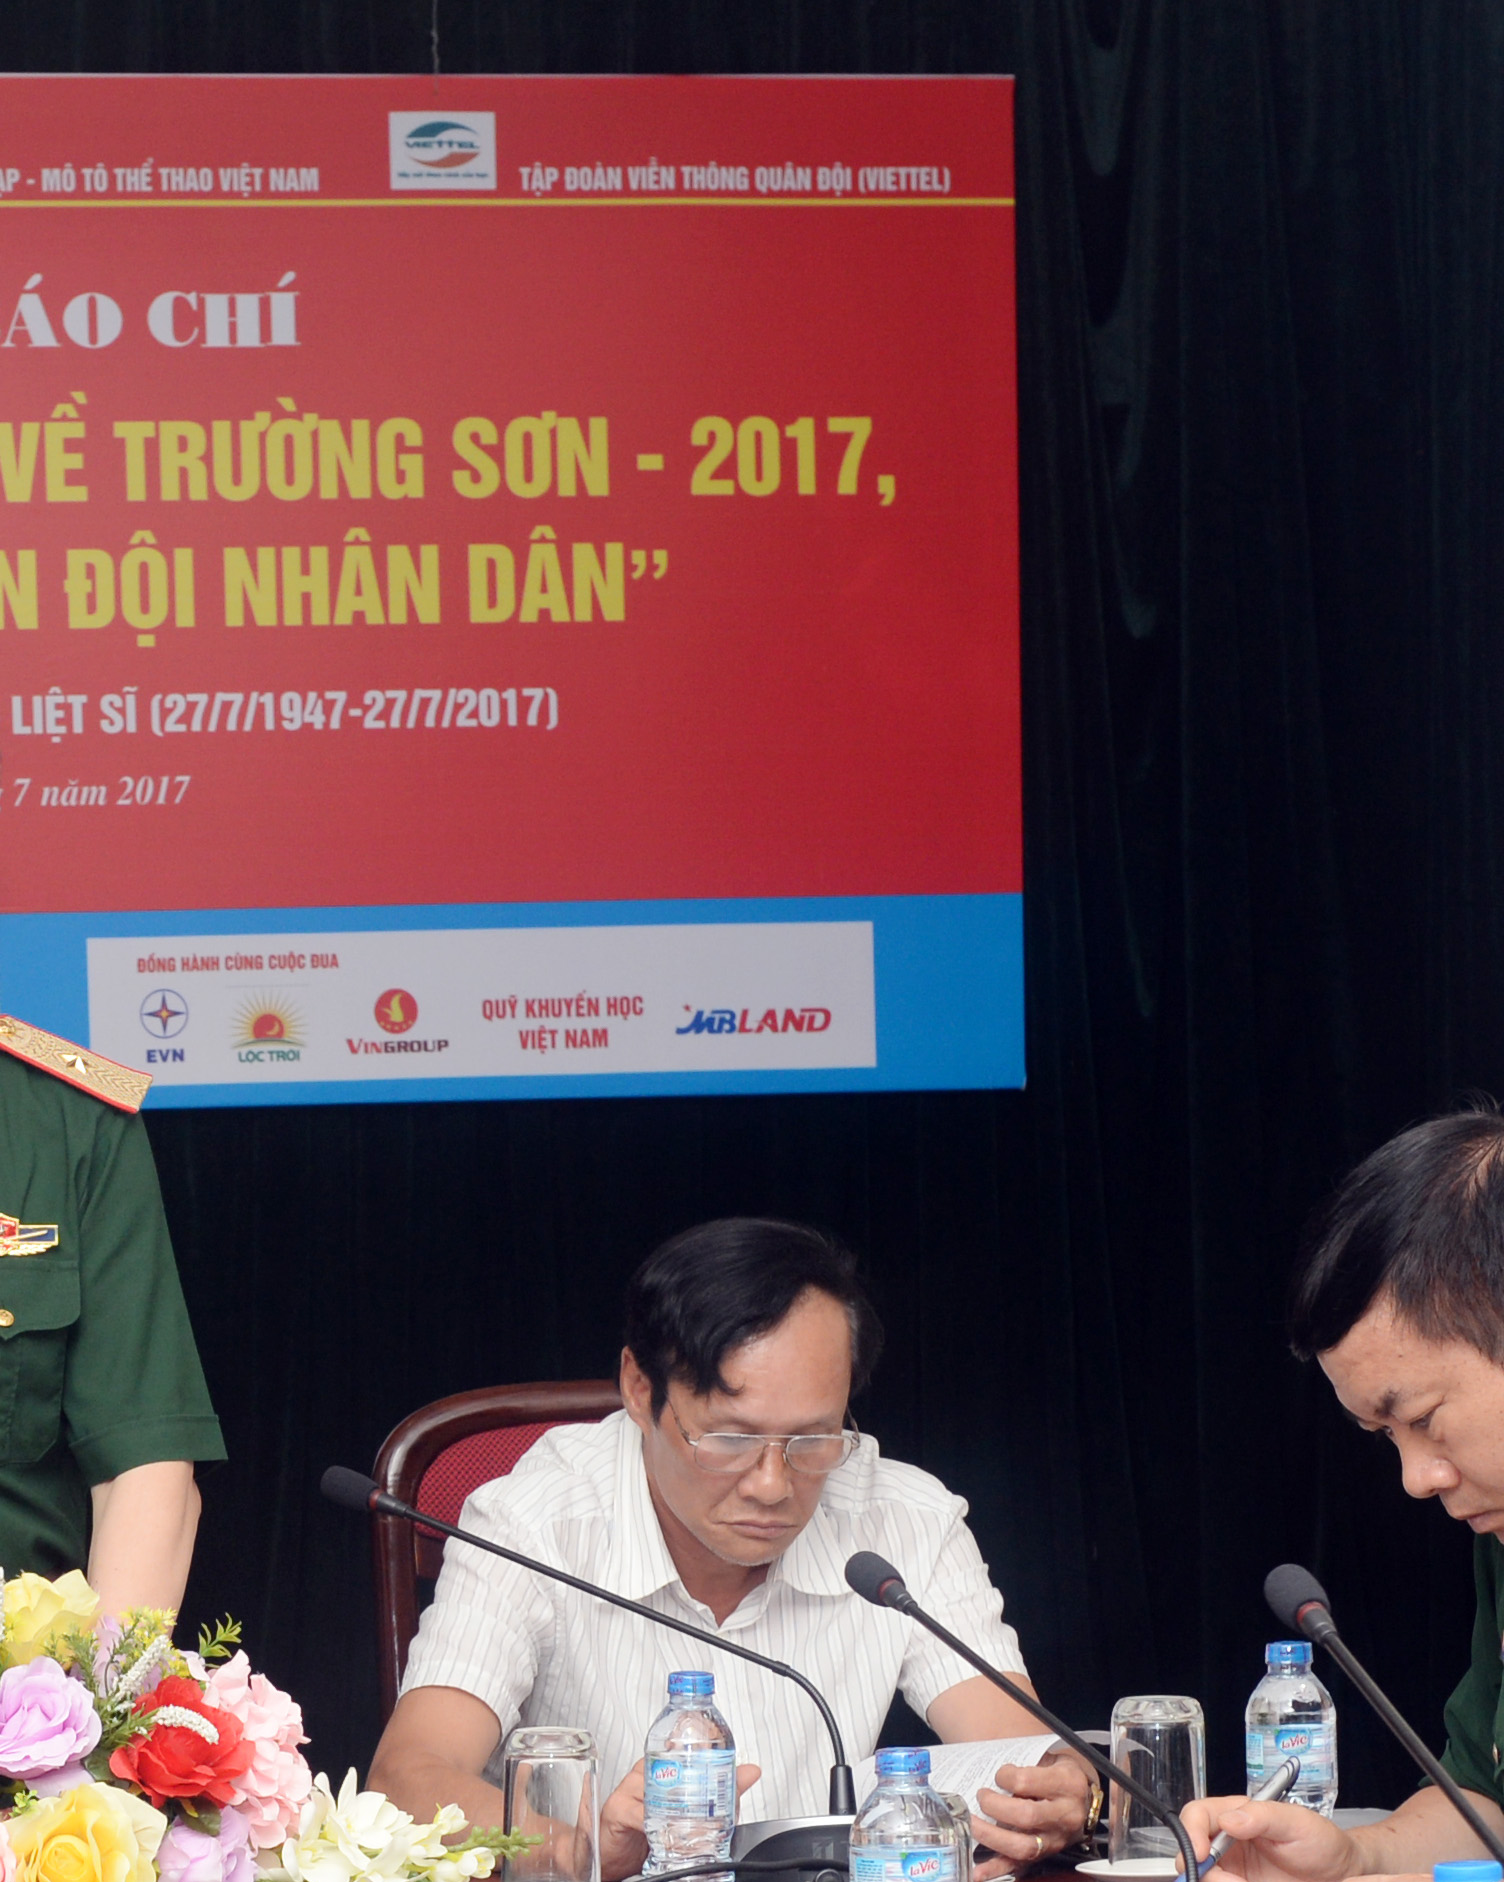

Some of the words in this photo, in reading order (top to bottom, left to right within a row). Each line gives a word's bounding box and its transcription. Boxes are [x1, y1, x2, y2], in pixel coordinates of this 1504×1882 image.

[41, 162, 76, 192] MÔ
[81, 162, 108, 192] TÔ
[114, 156, 154, 192] THỂ
[158, 166, 213, 192] THAO
[218, 162, 263, 197] VIỆT
[269, 166, 319, 192] NAM
[519, 161, 559, 197] TẬP
[564, 160, 622, 191] ĐOÀN
[627, 156, 676, 191] VIỄN
[682, 160, 749, 191] THÔNG
[755, 160, 811, 192] QUÂN
[816, 160, 852, 197] ĐỘI
[857, 165, 951, 193] (VIETTEL)
[146, 270, 302, 349] CHÍ
[113, 395, 425, 501] TRƯỜNG
[451, 409, 609, 498] SƠN
[635, 453, 665, 470] -
[689, 415, 898, 505] 2017,
[65, 530, 195, 647] ĐỘI
[223, 526, 440, 628] NHÂN
[12, 686, 87, 744] LIỆT
[100, 686, 139, 734] SĨ
[151, 687, 559, 736] (27/7/1947-27/7/2017)
[13, 776, 30, 806] 7
[41, 778, 107, 806] năm
[117, 775, 190, 805] 2017
[137, 952, 175, 974] ĐỒNG
[182, 952, 220, 972] HÀNH
[225, 951, 263, 971] CÙNG
[269, 950, 305, 973] CUỘC
[311, 953, 339, 969] ĐUA
[481, 995, 519, 1021] QUỸ
[525, 989, 600, 1019] KHUYẾN
[606, 996, 644, 1021] HỌC
[146, 1049, 185, 1063] EVN
[519, 1025, 557, 1054] VIỆT
[565, 1028, 609, 1049] NAM
